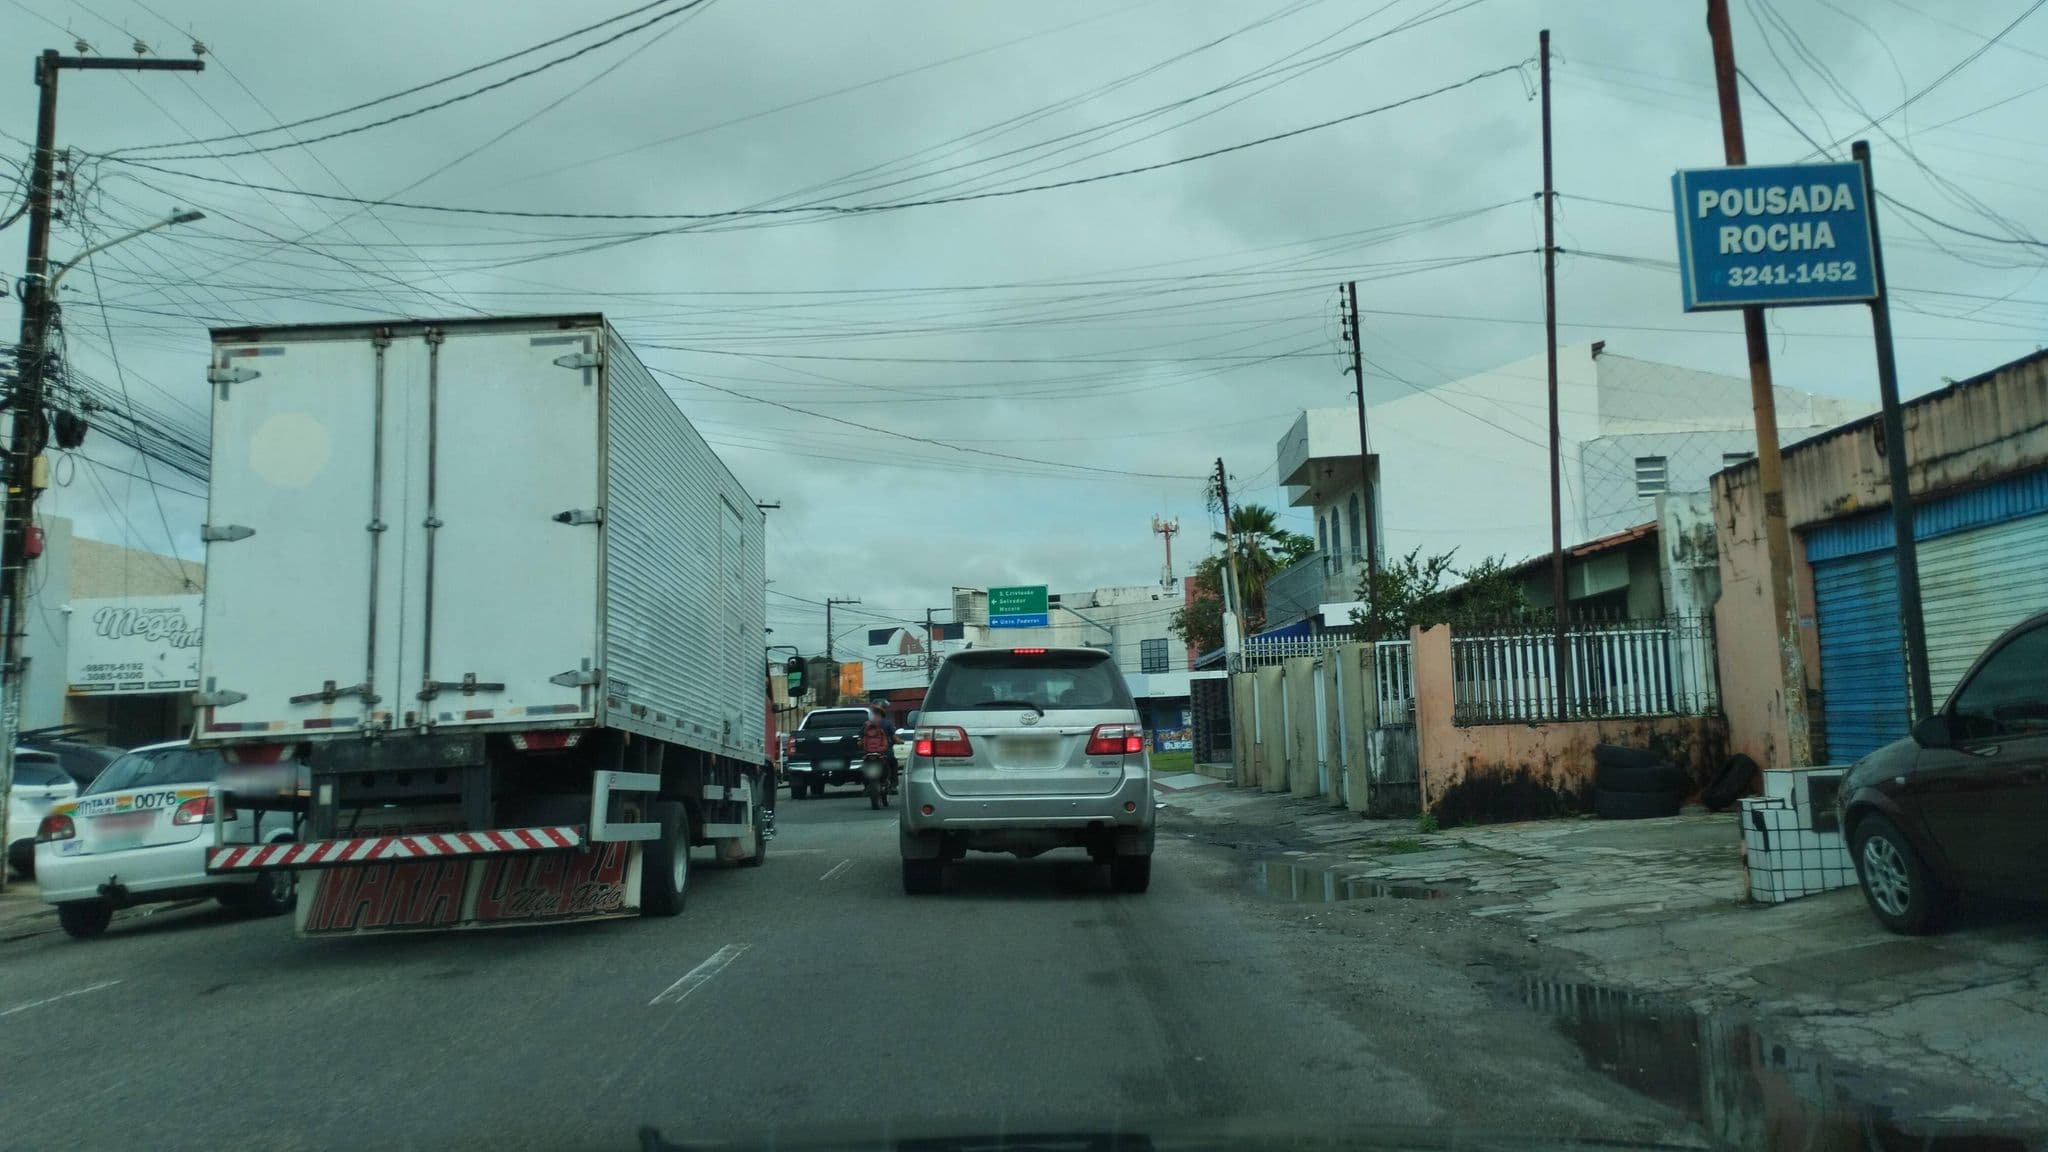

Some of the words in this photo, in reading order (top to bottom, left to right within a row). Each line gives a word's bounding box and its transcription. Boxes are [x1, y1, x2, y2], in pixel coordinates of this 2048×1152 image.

[1698, 184, 1856, 219] POUSADA
[1719, 221, 1836, 255] ROCHA
[1728, 261, 1857, 287] 3241-1452
[93, 606, 187, 642] Mega
[876, 655, 908, 670] Casa
[91, 797, 114, 808] TAXI
[134, 791, 177, 810] 0076
